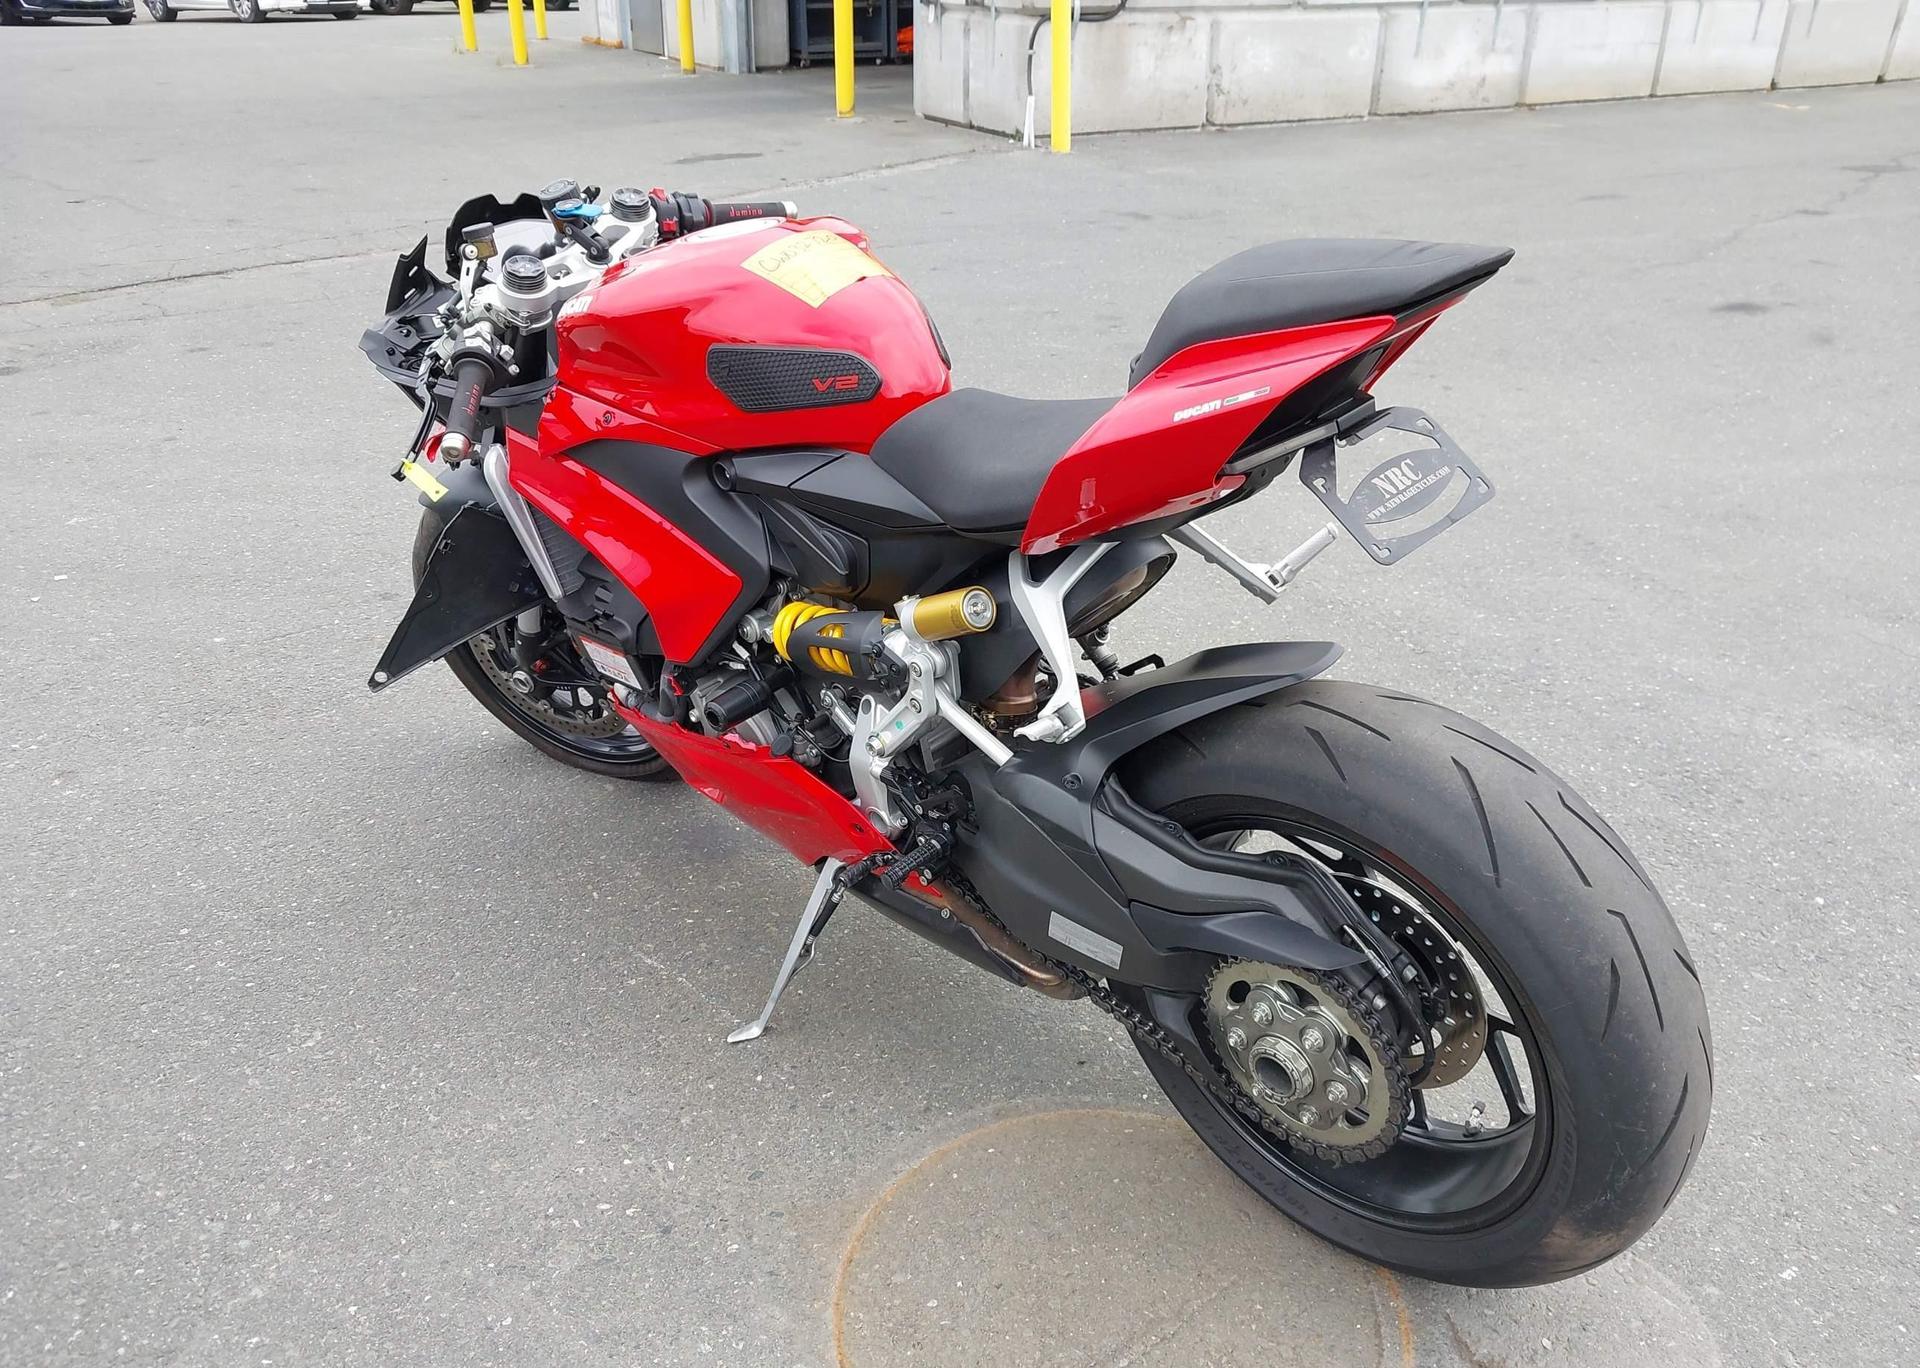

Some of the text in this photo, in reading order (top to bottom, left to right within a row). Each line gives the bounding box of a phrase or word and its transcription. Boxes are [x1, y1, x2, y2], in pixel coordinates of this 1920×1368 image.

[811, 374, 859, 393] V2
[1173, 399, 1222, 423] DUCATI
[1367, 465, 1451, 520] WWW.NEWRAGECYCLES.COM
[1371, 458, 1422, 499] NRC
